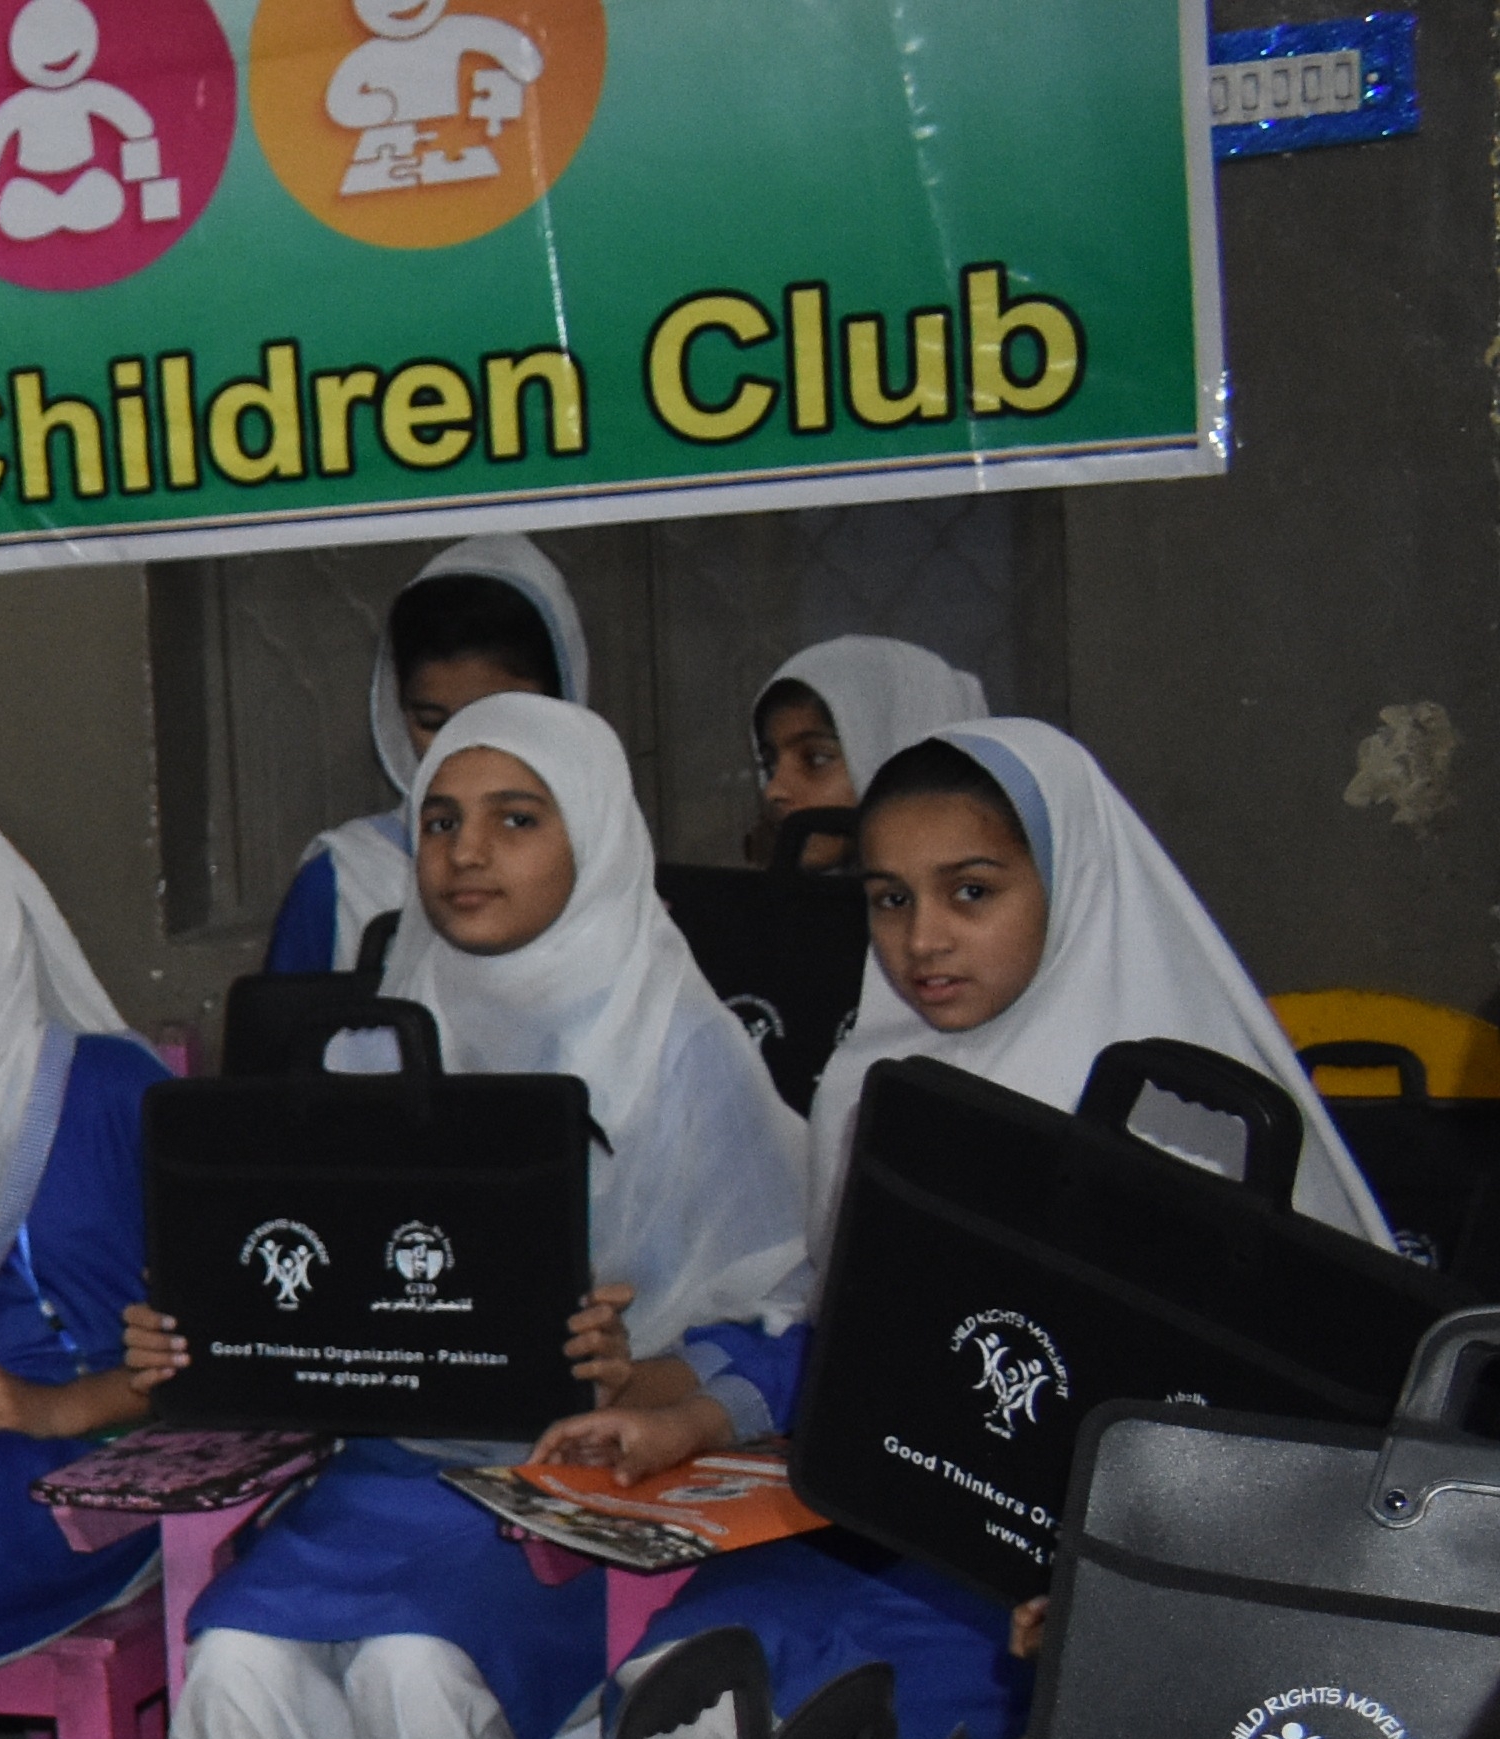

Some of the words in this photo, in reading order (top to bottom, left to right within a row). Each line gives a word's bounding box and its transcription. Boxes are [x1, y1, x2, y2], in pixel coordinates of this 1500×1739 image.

[643, 262, 1088, 445] Club
[210, 1340, 253, 1357] Good
[323, 1345, 425, 1364] Organization
[437, 1348, 510, 1367] Pakistan
[882, 1434, 938, 1473] Good
[941, 1459, 1026, 1517] Thinkers
[1263, 1687, 1343, 1717] RIGHTS
